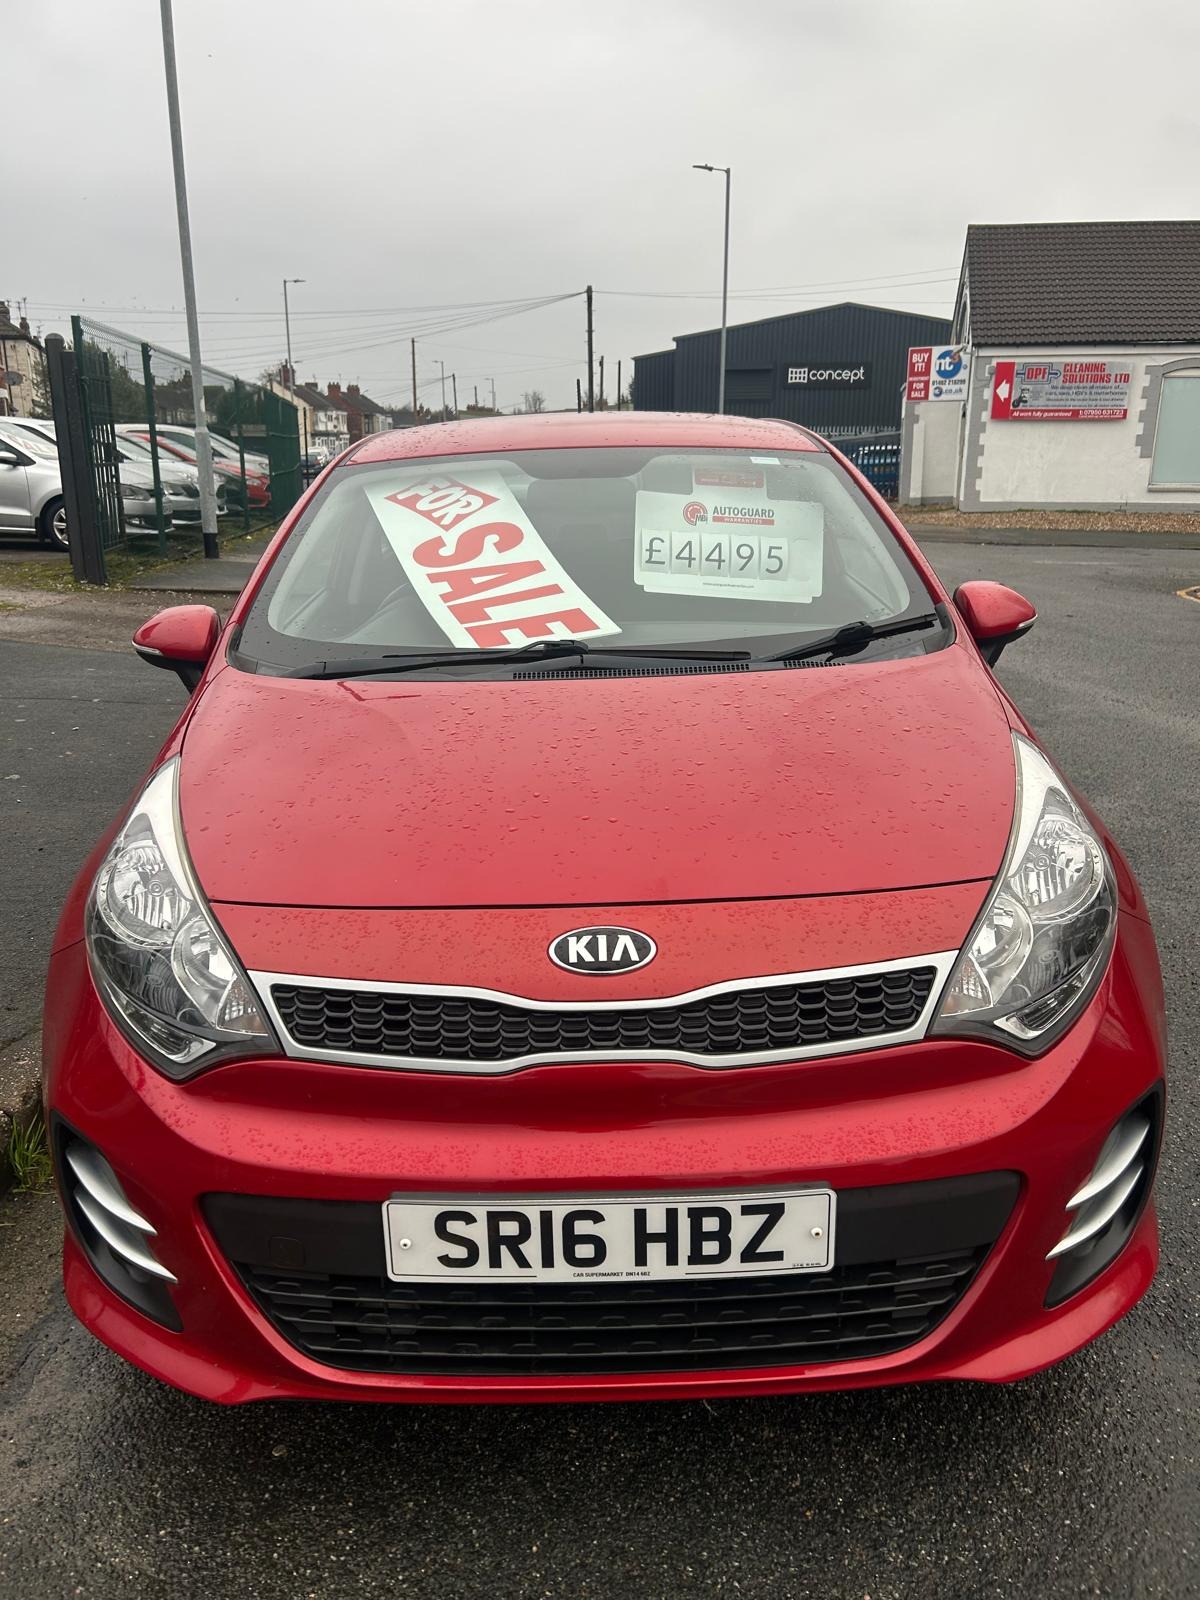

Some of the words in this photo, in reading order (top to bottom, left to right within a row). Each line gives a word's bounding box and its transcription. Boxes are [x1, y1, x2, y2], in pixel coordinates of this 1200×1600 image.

[912, 352, 929, 363] BUY
[914, 362, 925, 372] IT!
[1026, 367, 1049, 379] DPF
[1063, 363, 1106, 373] CLEANING
[809, 366, 864, 383] concept
[1062, 373, 1111, 384] SOLUTIONS
[1113, 373, 1130, 384] LTD
[911, 390, 925, 398] SALE
[397, 477, 484, 525] FOR
[712, 505, 775, 518] AUTOGUARD
[645, 537, 784, 574] £4495
[412, 521, 601, 649] SALE
[567, 934, 640, 963] KIA
[433, 1209, 608, 1269] SR16
[633, 1202, 786, 1267] HBZ
